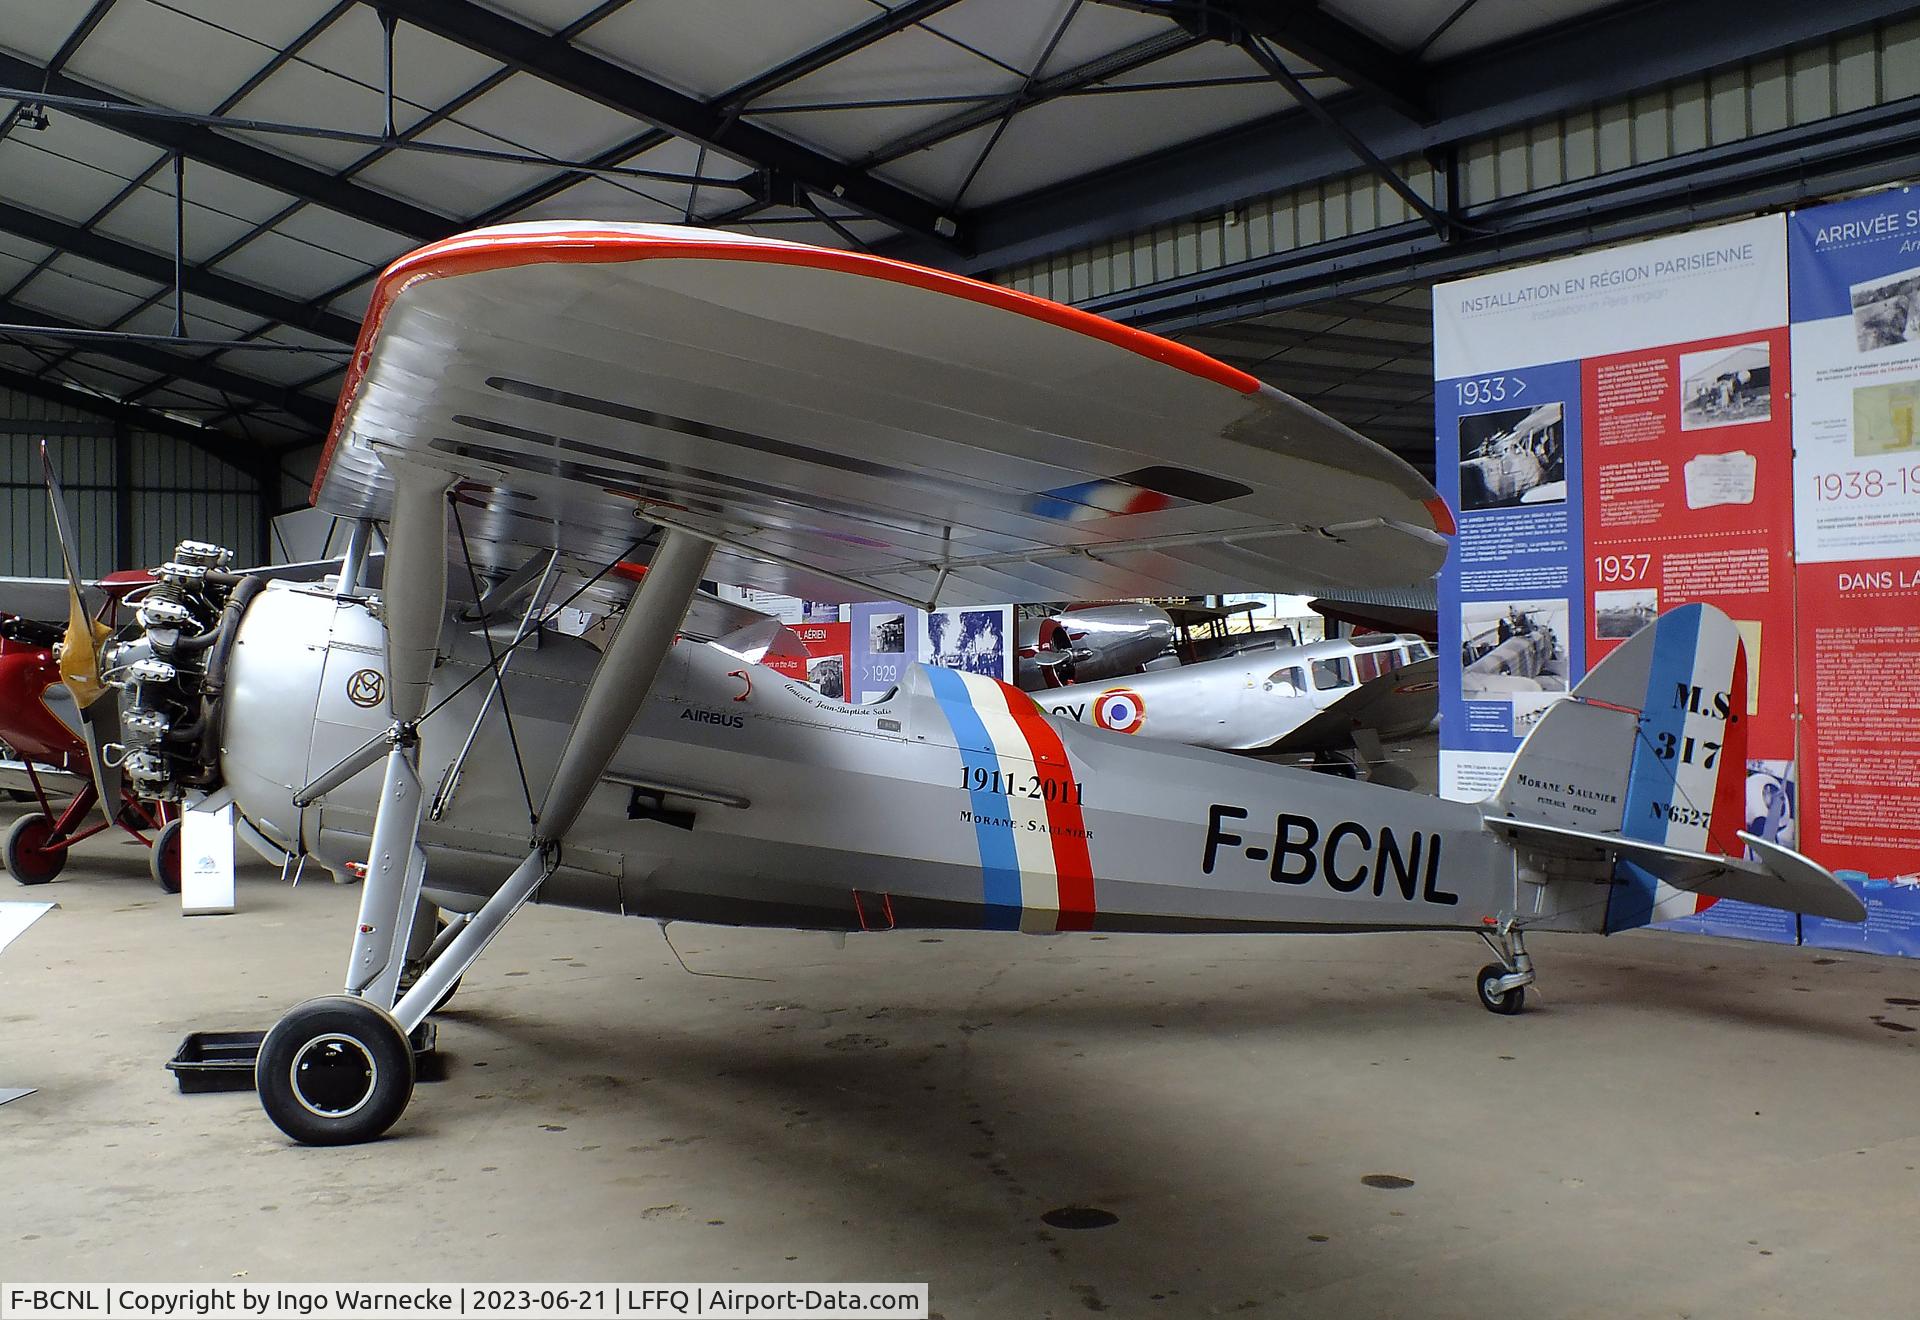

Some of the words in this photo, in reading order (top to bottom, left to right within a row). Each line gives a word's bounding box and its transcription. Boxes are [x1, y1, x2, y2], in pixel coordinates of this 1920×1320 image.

[1815, 213, 1899, 246] ARRIVÉE
[1906, 209, 1920, 227] S
[1461, 283, 1560, 313] INSTALLATION
[1565, 278, 1585, 293] EN
[1591, 266, 1650, 288] RÉGION
[1655, 244, 1753, 276] PARISIENNE
[1456, 377, 1506, 406] 1933
[1595, 553, 1651, 582] 1937
[1839, 571, 1893, 591] DANS
[803, 627, 827, 640] AÉRIEN
[872, 665, 897, 682] 1929
[784, 683, 815, 704] Amicale
[815, 700, 870, 716] Jean-Baptiste
[1672, 682, 1739, 724] M.S.
[680, 708, 744, 729] AIRBUS
[1655, 731, 1722, 770] 317
[960, 766, 1085, 807] 1911-2011
[1572, 804, 1598, 816] FRANCE
[1202, 803, 1460, 906] F-BCNL
